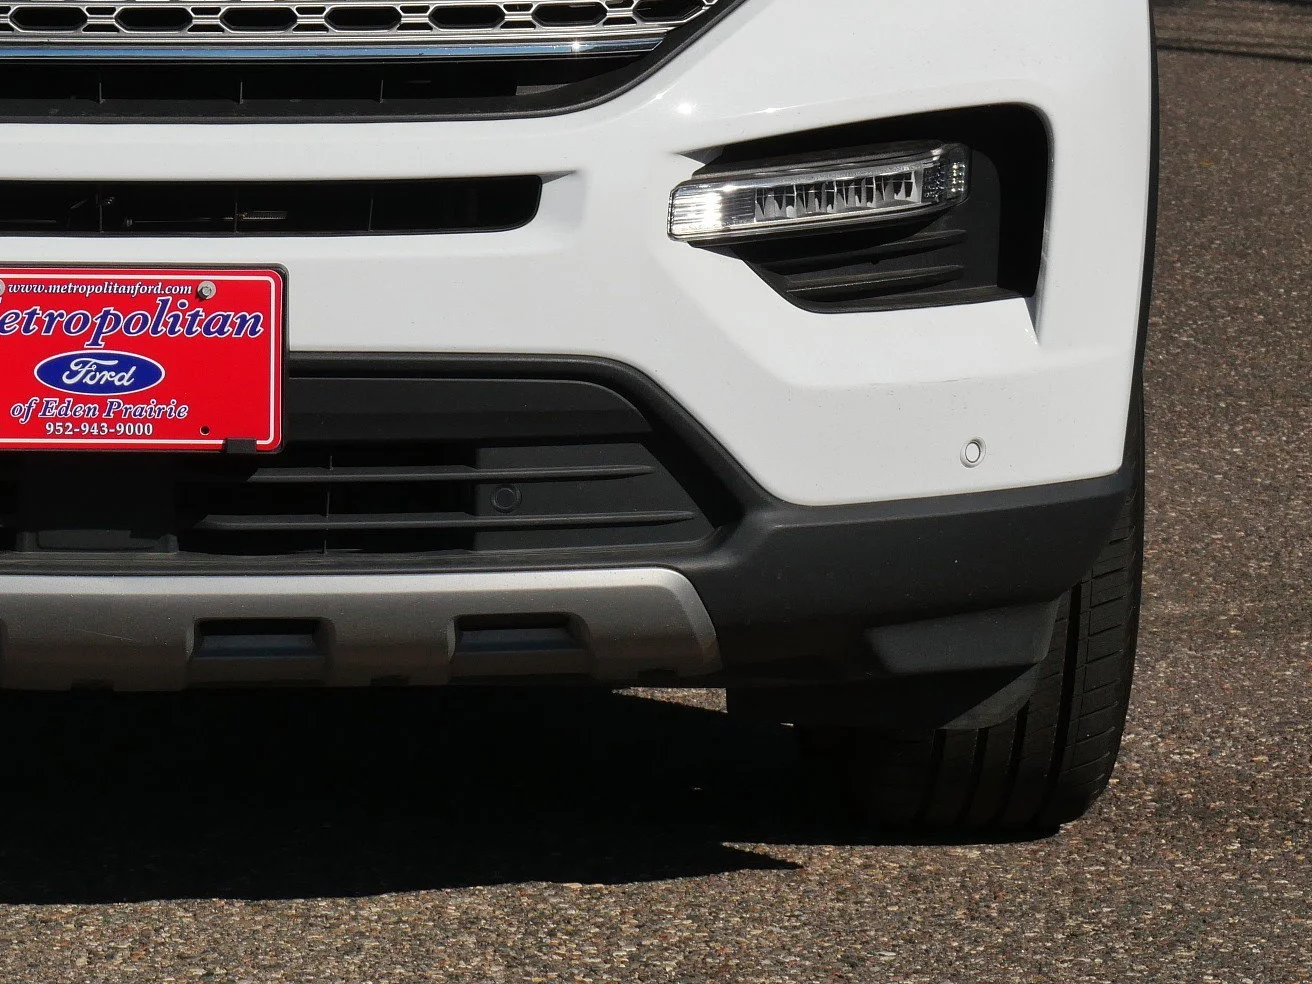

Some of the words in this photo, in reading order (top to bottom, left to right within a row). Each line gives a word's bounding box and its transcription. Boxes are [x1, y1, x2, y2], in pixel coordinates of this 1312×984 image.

[8, 281, 192, 297] www.metropolitanford.com
[61, 358, 136, 386] Ford
[10, 398, 40, 423] of
[38, 398, 98, 418] Eden
[103, 398, 189, 419] Prairie
[45, 422, 153, 436] 952-943-9000
